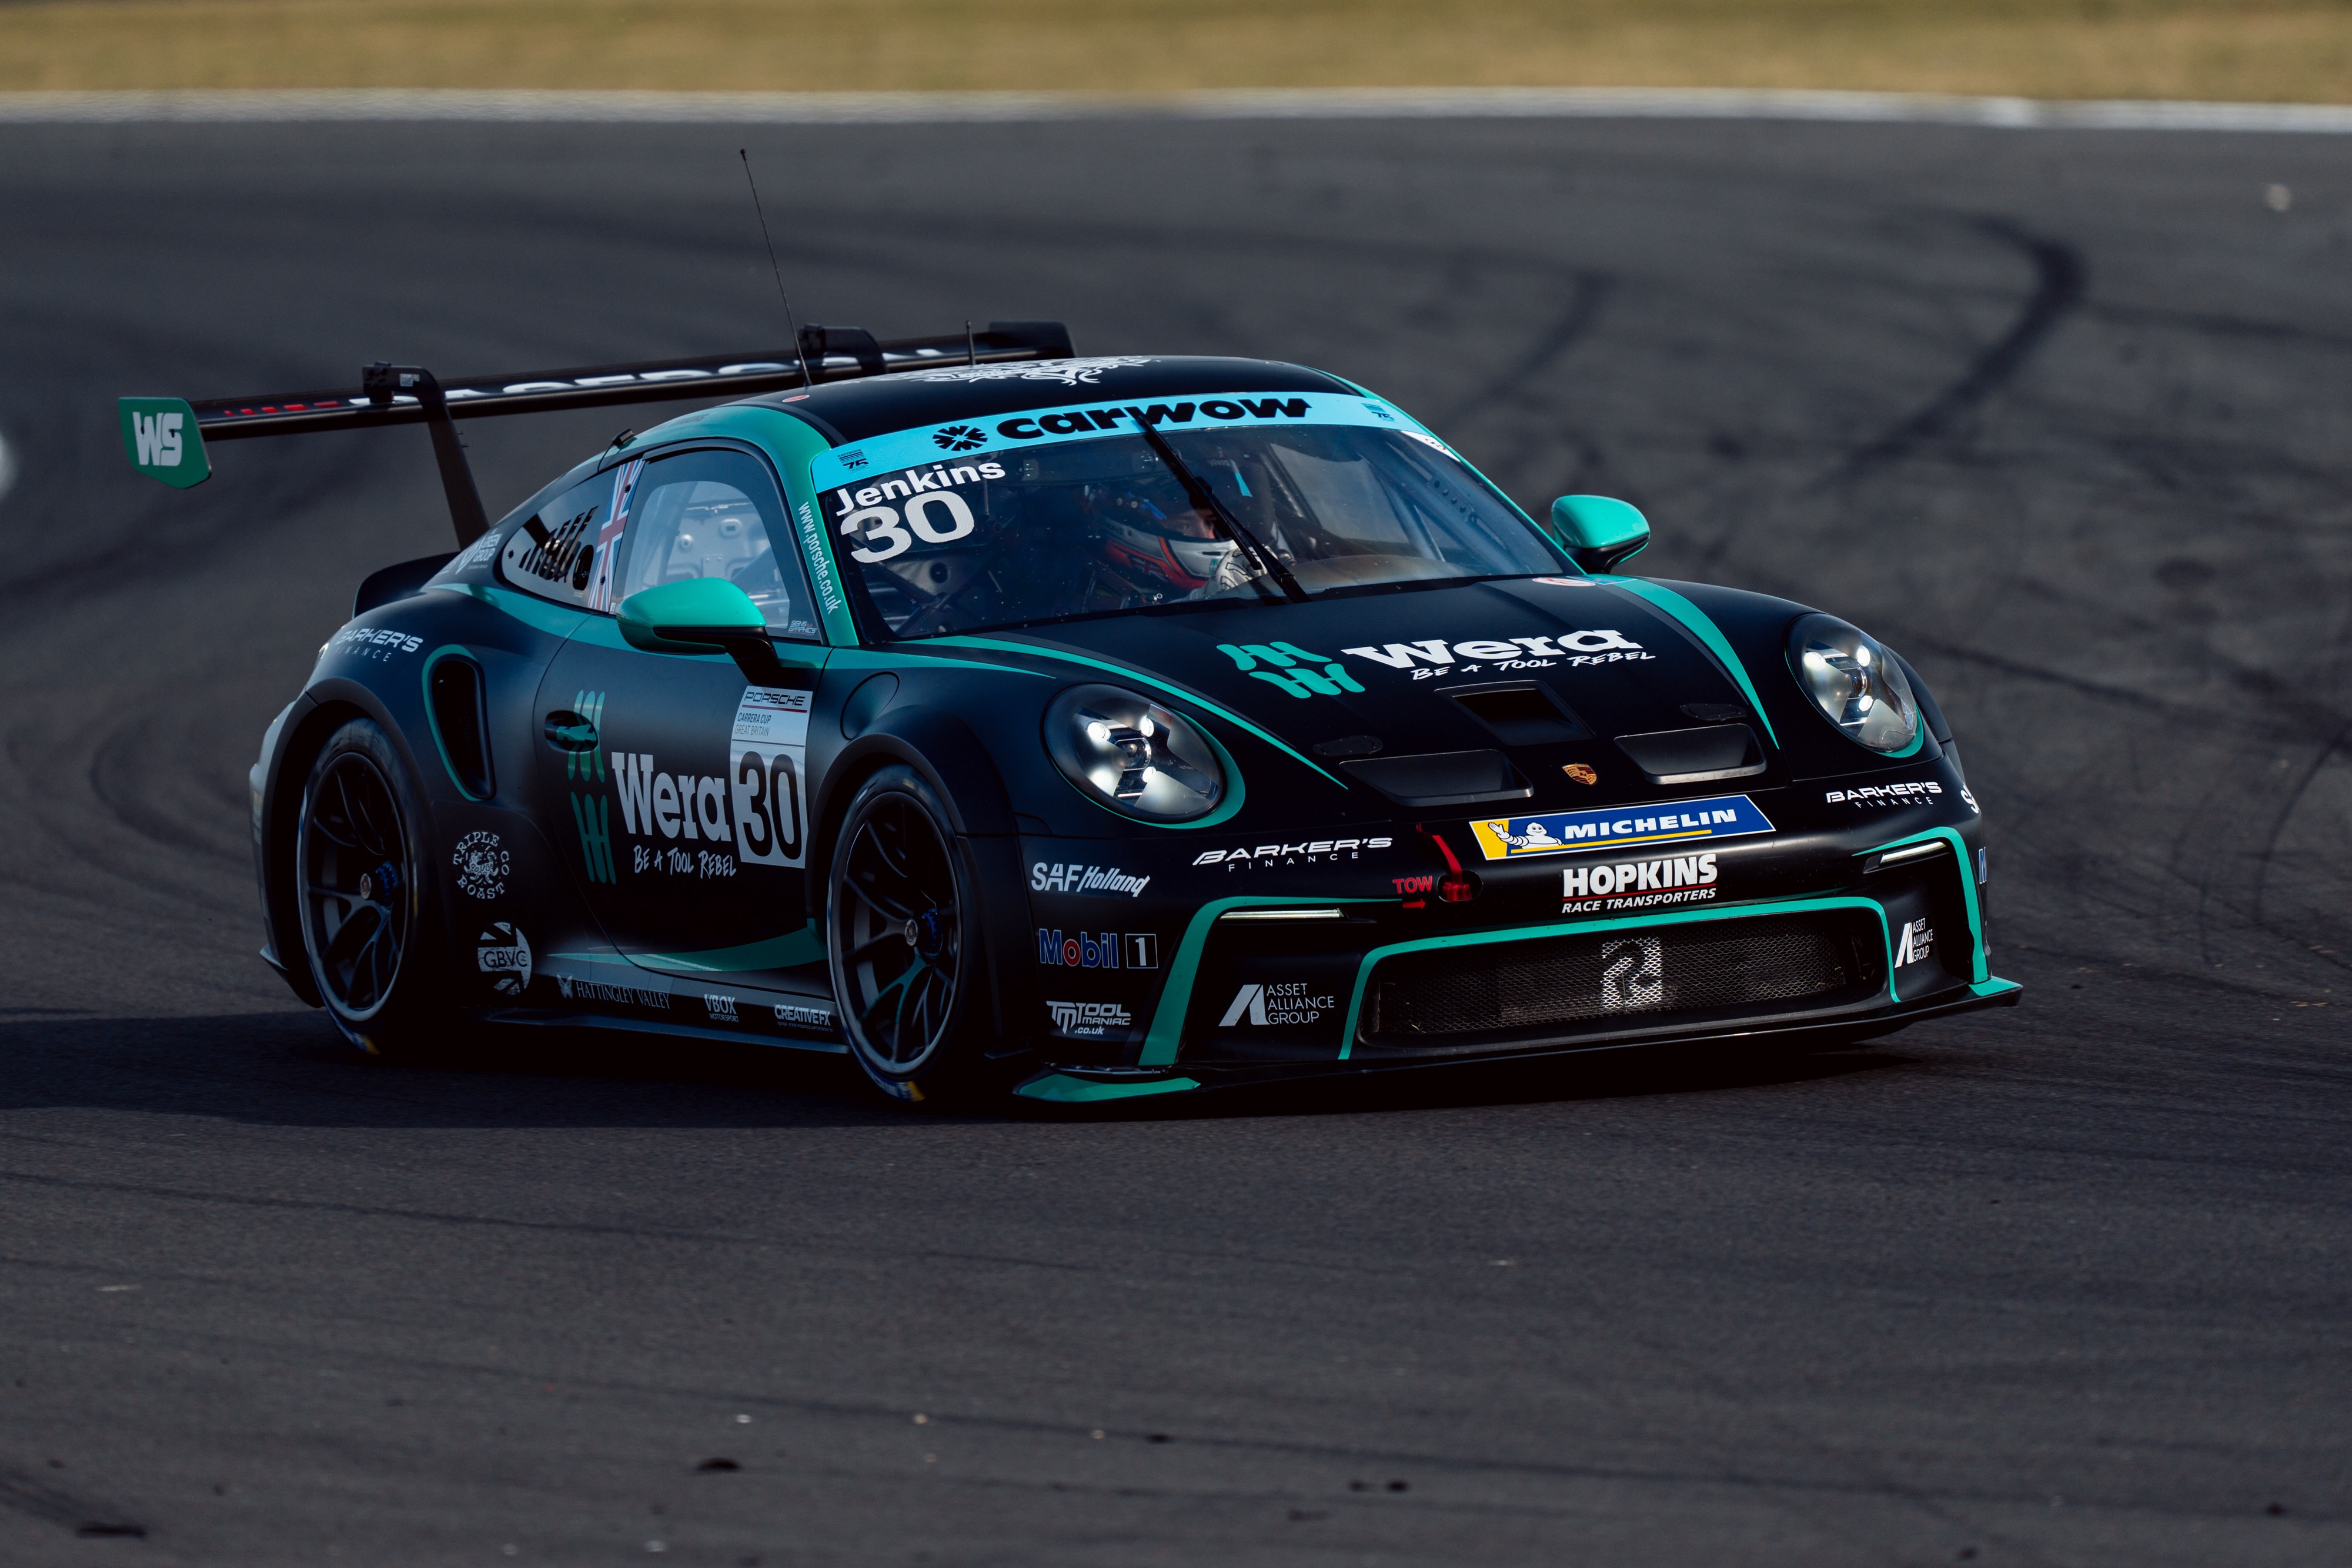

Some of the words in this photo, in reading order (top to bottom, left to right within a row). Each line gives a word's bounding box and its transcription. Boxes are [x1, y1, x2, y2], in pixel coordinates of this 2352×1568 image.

[997, 398, 1312, 440] carwow
[132, 411, 183, 466] WS
[843, 458, 869, 469] 75
[836, 462, 1006, 516] Jenkins
[840, 490, 975, 563] 30
[798, 501, 841, 615] www.porsche.co.uk
[335, 628, 424, 653] BARKER'S
[1341, 629, 1644, 670] Wera
[1411, 666, 1451, 680] BE
[1460, 663, 1482, 673] A
[1493, 658, 1558, 671] TOOL
[1566, 651, 1656, 667] REBEL
[744, 691, 806, 706] PORSCHE
[737, 713, 760, 724] CARRERA
[760, 714, 771, 724] CUP
[735, 724, 750, 735] GREAT
[751, 726, 770, 737] BRITAIN
[612, 751, 731, 842] Wera
[1826, 781, 1942, 804] BARKER'S
[1855, 796, 1934, 808] FINANCE
[739, 751, 802, 860] 30
[1565, 808, 1737, 840] MICHELIN
[453, 830, 500, 865] TRIPLE
[1192, 837, 1394, 866] BARKER'S
[633, 844, 650, 874] BE
[653, 850, 663, 872] A
[667, 847, 694, 876] TOOL
[698, 850, 737, 880] REBEL
[1228, 851, 1359, 872] FINANCE
[457, 874, 506, 899] ROAST
[1031, 862, 1083, 892] SAF
[1076, 866, 1151, 898] Holland
[1393, 876, 1433, 894] TOW
[1562, 854, 1718, 898] HOPKINS
[1562, 900, 1601, 914] RACE
[1606, 888, 1716, 911] TRANSPORTERS
[1912, 917, 1926, 934] ASSET
[1038, 928, 1119, 969] Mobil
[1135, 937, 1147, 967] 1
[1913, 928, 1933, 948] ALLIANCE
[484, 950, 527, 968] GBVC
[1913, 945, 1930, 962] GROUP
[576, 982, 634, 1004] HATTINGLEY
[636, 989, 670, 1009] VALLEY
[1266, 982, 1308, 997] ASSET
[704, 994, 737, 1015] VBOX
[1075, 1002, 1131, 1024] TOOL
[1267, 995, 1335, 1011] ALLIANCE
[709, 1012, 740, 1023] MOTORSPORT
[774, 1004, 831, 1027] CREATIVEFX
[1082, 1017, 1131, 1026] MANIAC
[1268, 1010, 1320, 1025] GROUP
[1074, 1026, 1105, 1035] .co.uk
